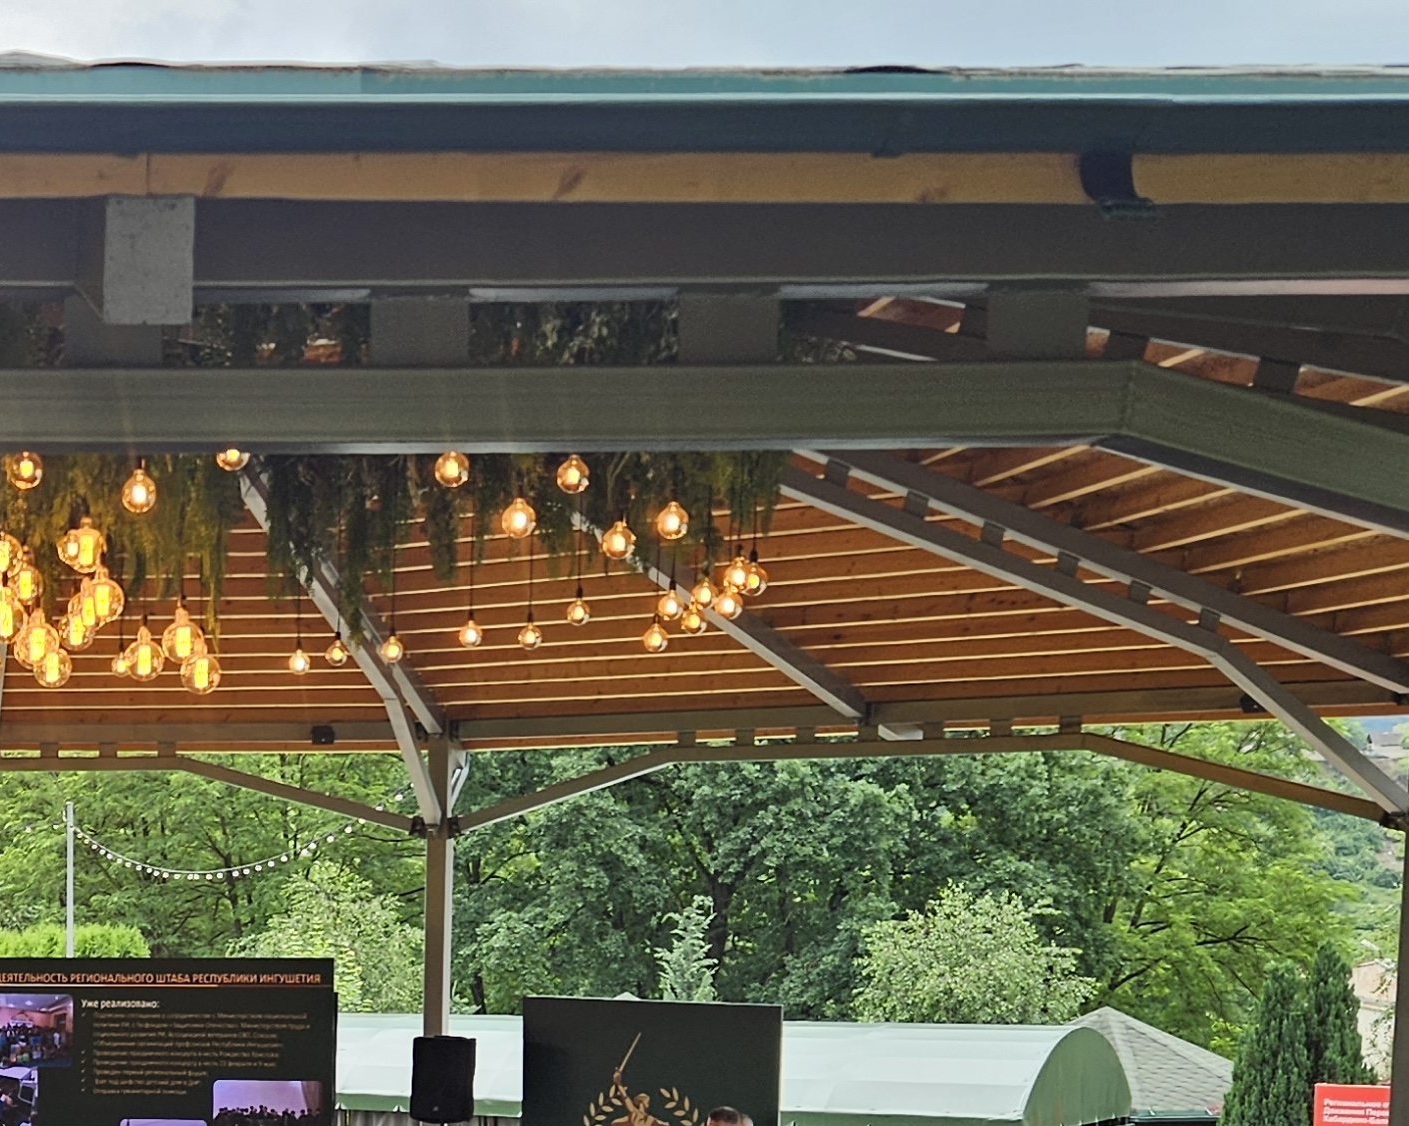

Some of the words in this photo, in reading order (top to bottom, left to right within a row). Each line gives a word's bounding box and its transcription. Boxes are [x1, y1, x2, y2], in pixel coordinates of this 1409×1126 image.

[70, 972, 154, 983] РЕГИОНАЛЬНОГО
[155, 973, 191, 983] ШТАБА
[192, 973, 258, 983] РЕСПУБЛИКИ
[259, 973, 321, 984] ИНГУШЕТИЯ
